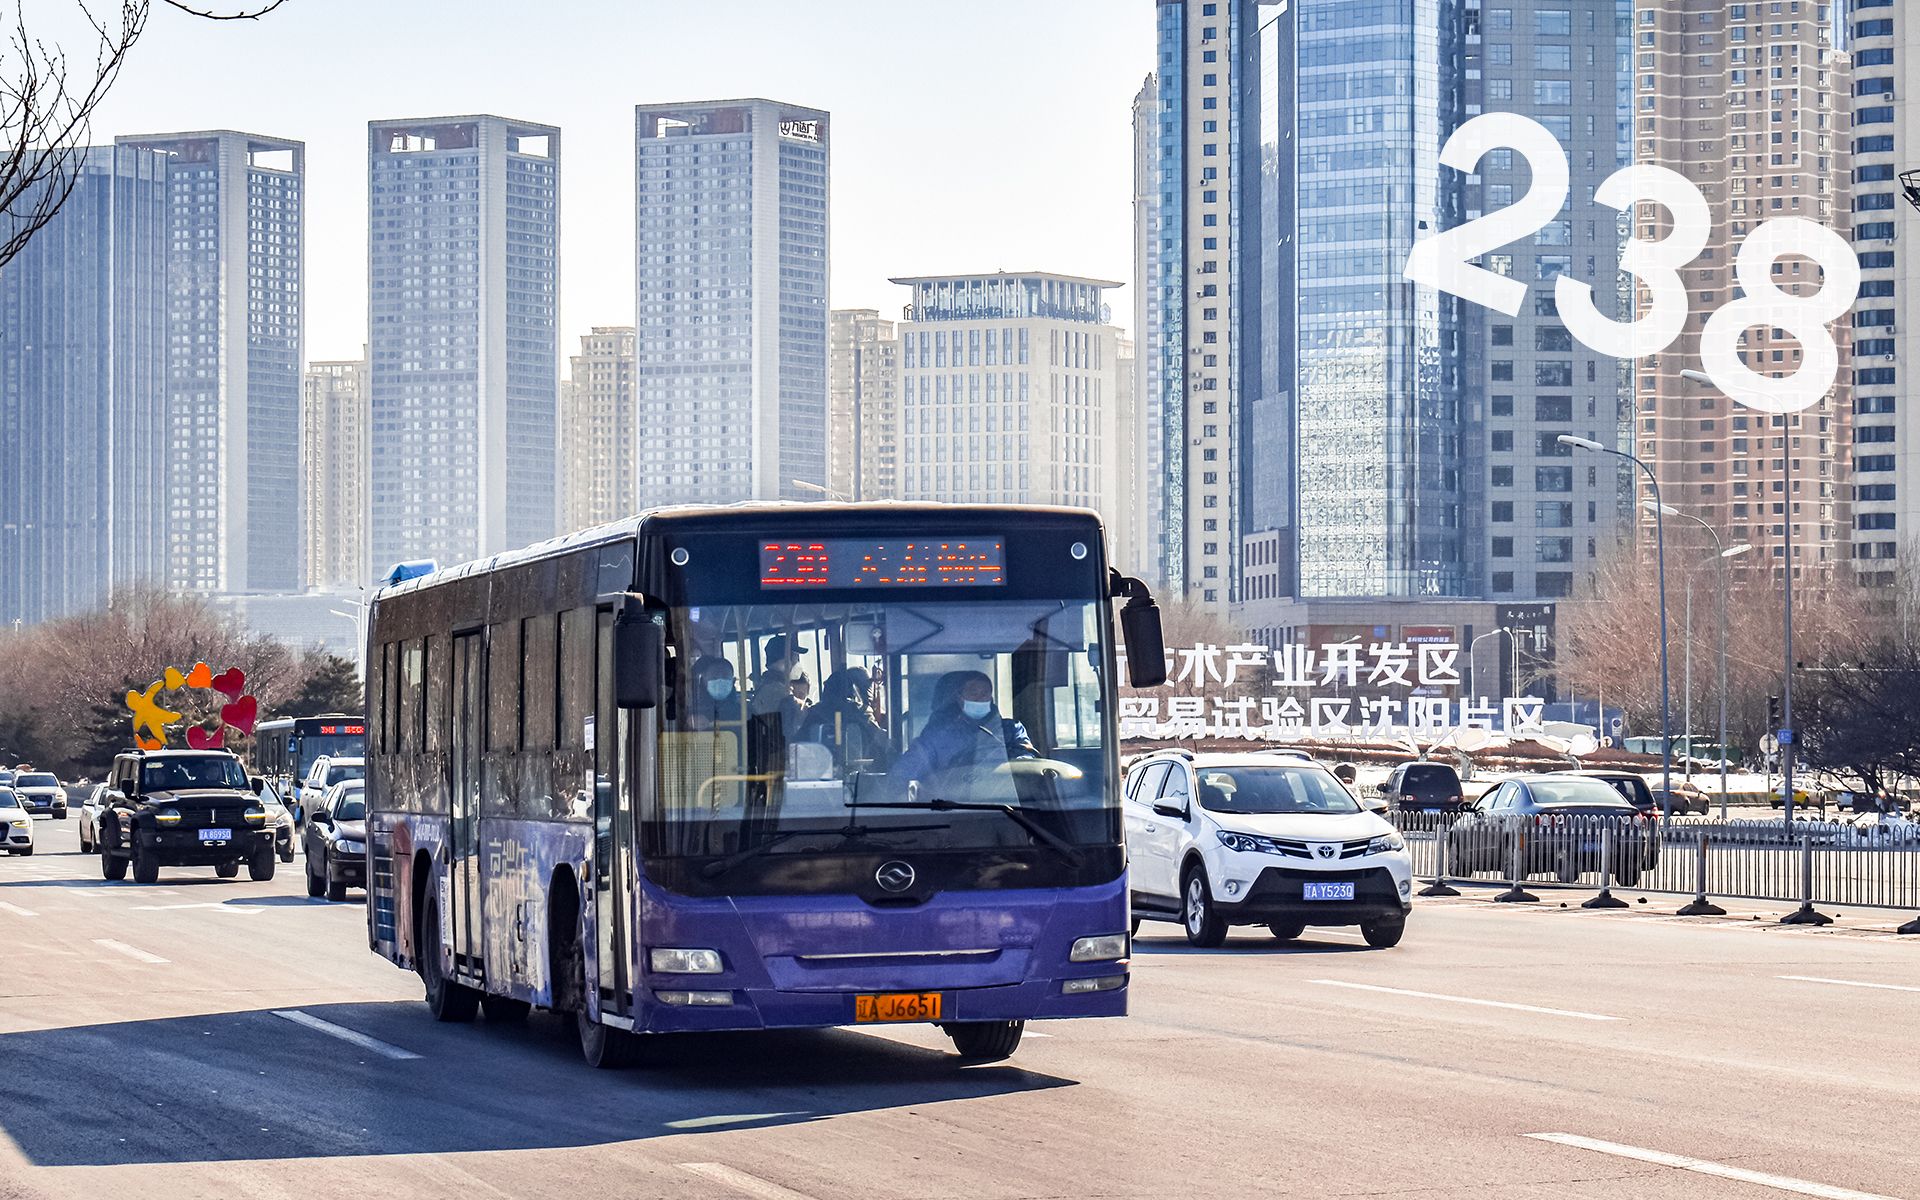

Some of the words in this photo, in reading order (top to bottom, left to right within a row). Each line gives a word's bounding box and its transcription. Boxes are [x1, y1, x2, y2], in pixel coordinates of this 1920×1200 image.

[1116, 642, 1461, 688] 术产业开发区
